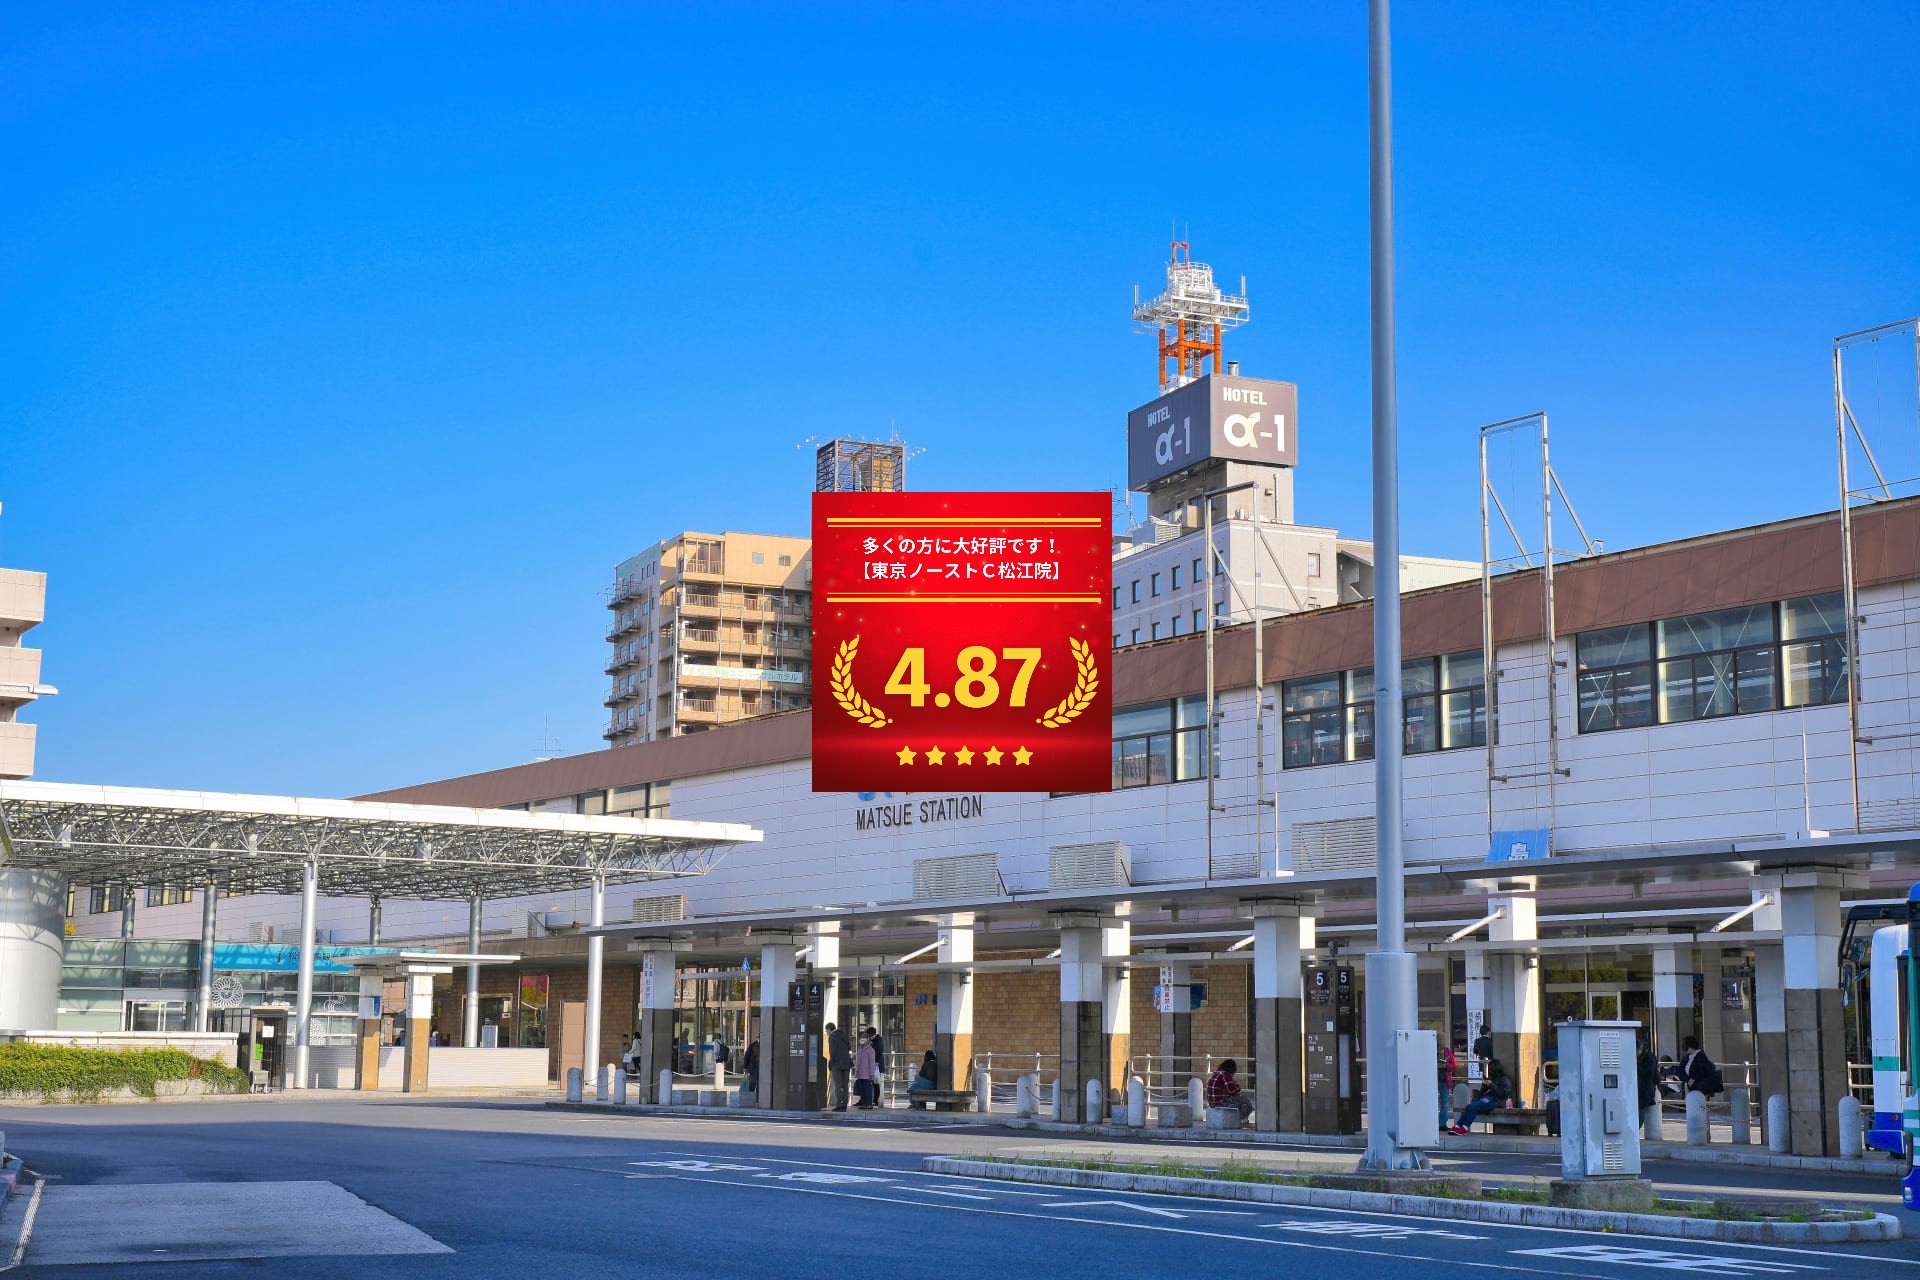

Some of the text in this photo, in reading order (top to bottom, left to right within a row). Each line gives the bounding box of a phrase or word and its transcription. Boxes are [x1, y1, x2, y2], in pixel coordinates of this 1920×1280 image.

[1223, 386, 1267, 406] HOTEL
[1147, 405, 1171, 428] HOTEL
[856, 794, 983, 831] MATSUE STATION
[1316, 972, 1325, 986] 5
[1340, 971, 1348, 983] 5
[795, 986, 801, 998] 4
[811, 985, 818, 995] 4
[1731, 982, 1738, 994] 1
